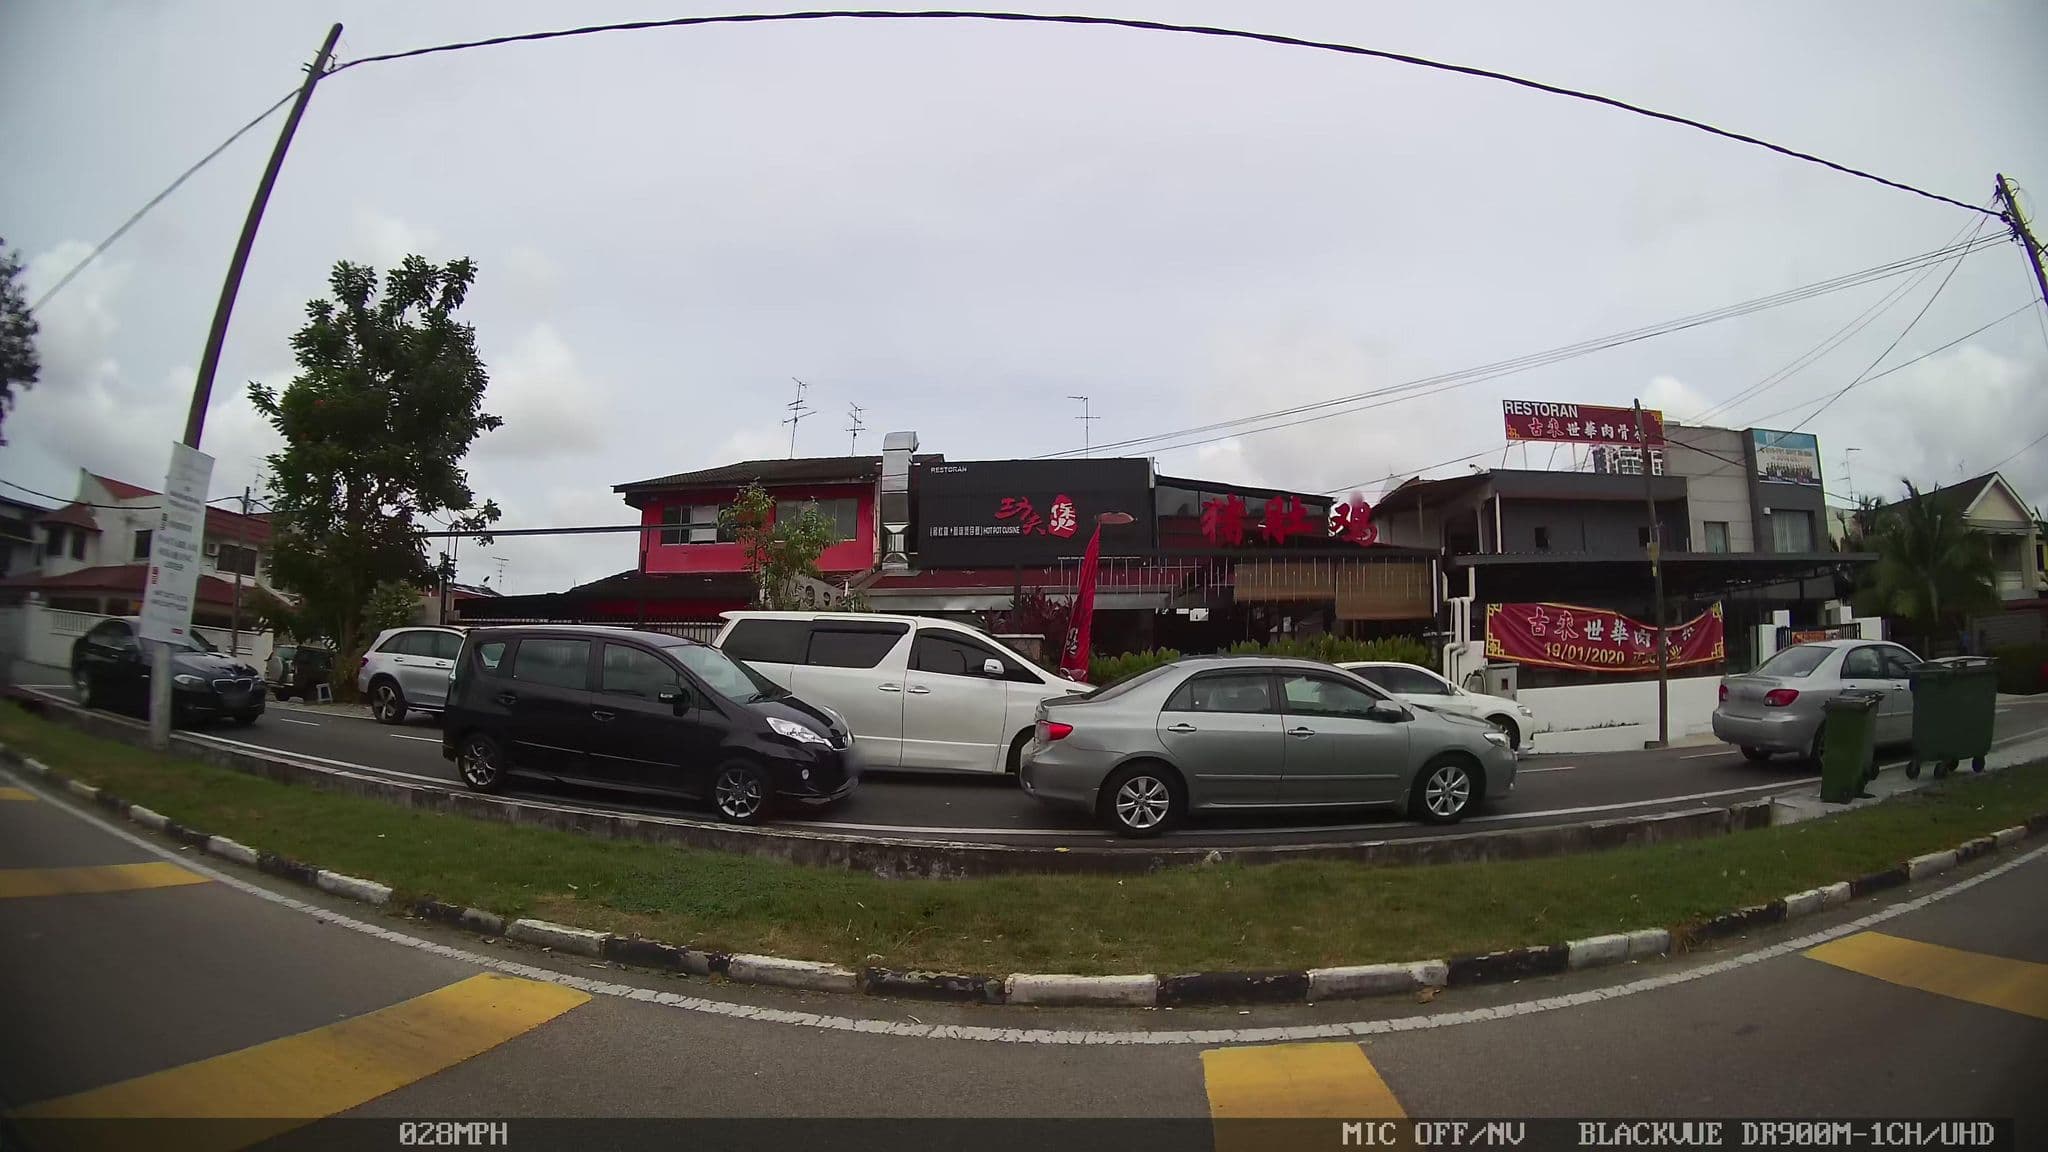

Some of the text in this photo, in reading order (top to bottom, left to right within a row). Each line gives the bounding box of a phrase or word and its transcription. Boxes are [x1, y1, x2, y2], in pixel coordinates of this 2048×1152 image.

[1503, 400, 1578, 418] RESTORAN
[930, 466, 967, 474] RESTORAN
[1545, 642, 1625, 666] 19/01/2020
